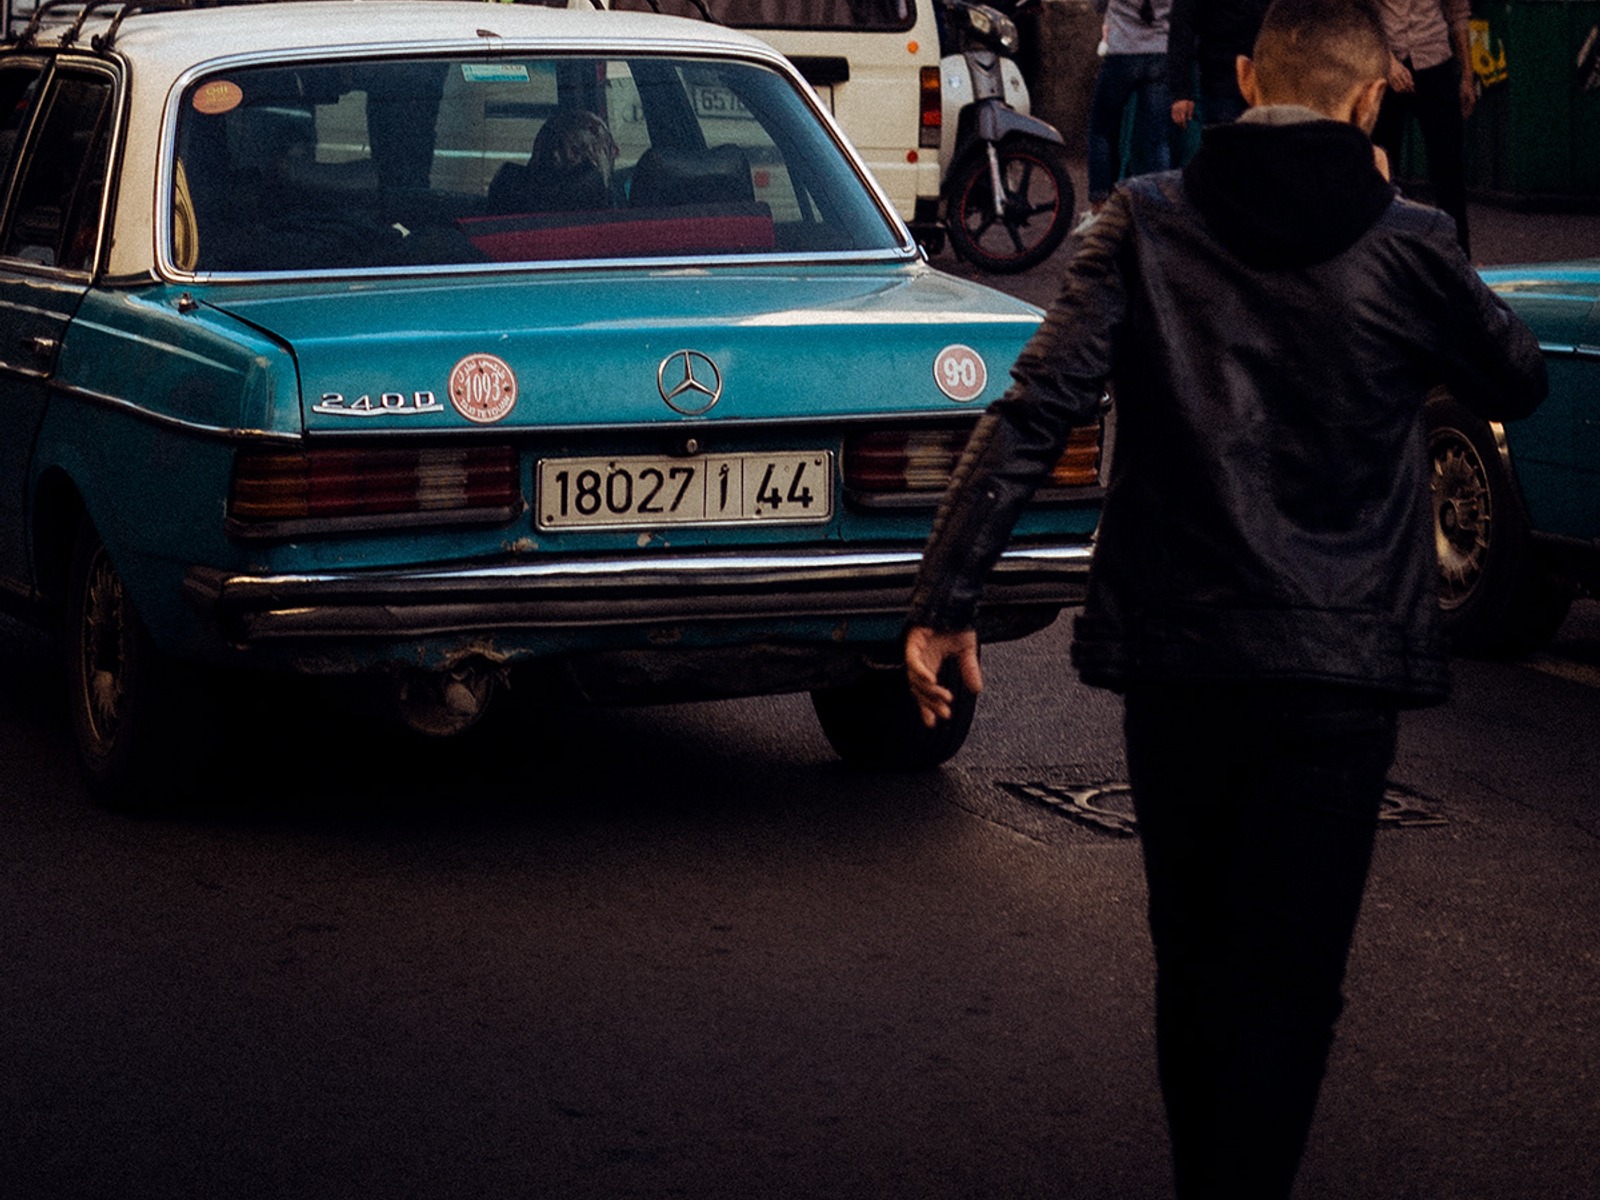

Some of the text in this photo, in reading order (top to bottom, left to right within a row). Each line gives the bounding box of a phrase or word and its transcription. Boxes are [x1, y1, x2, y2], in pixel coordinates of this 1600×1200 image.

[464, 372, 501, 404] 1093
[943, 357, 977, 388] 90
[555, 467, 695, 517] 18027
[756, 461, 814, 510] 44
